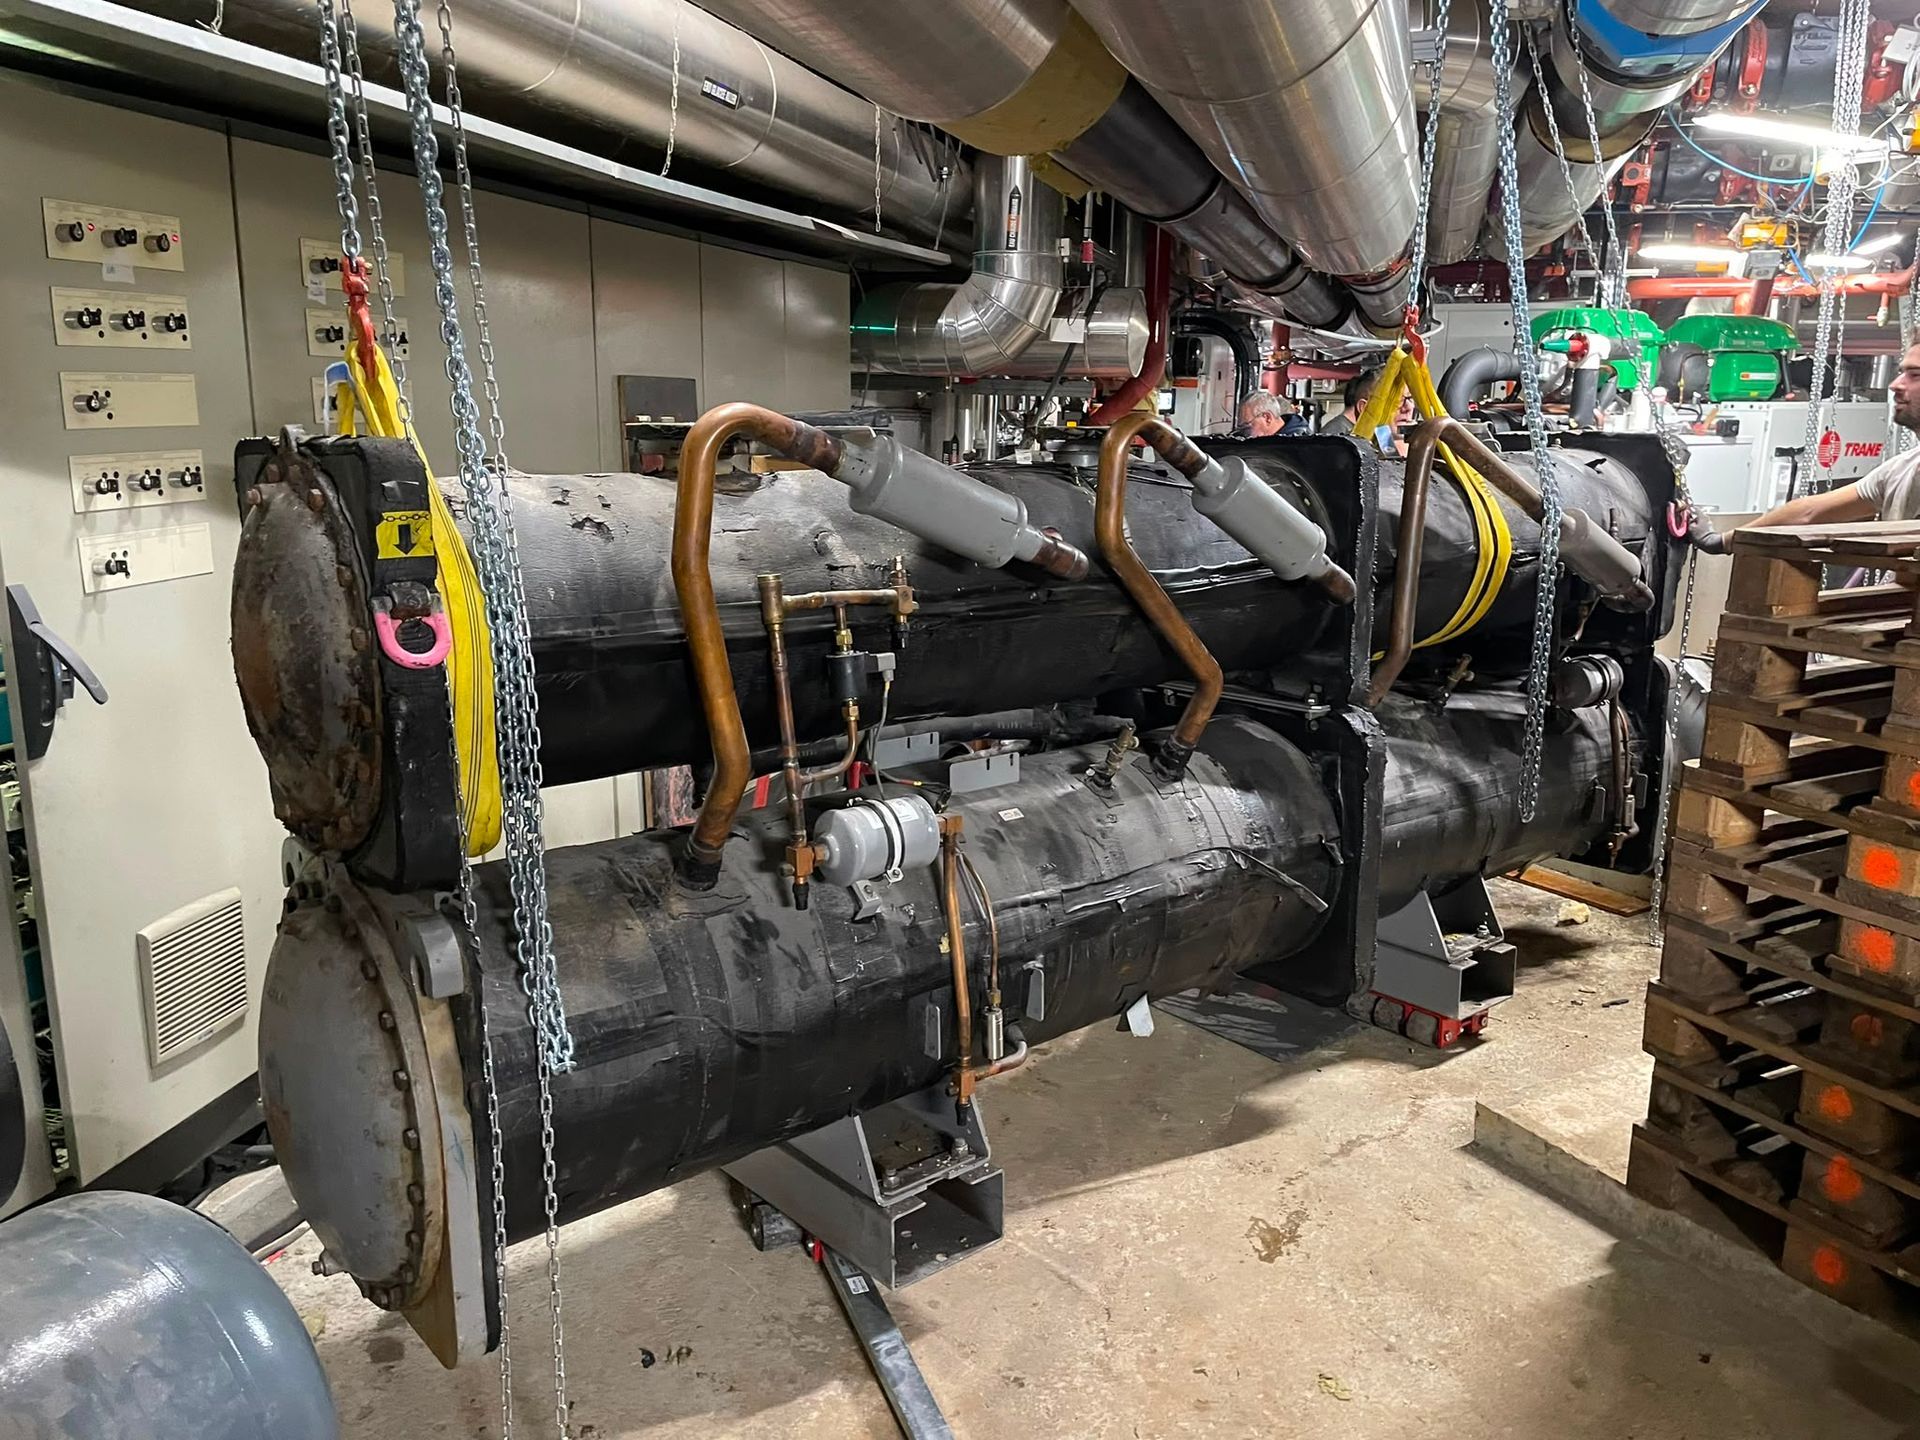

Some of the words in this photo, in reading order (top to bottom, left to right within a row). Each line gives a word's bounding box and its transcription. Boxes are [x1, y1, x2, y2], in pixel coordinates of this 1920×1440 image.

[1009, 220, 1017, 238] CHAUDE
[1008, 238, 1016, 247] EAU
[1845, 442, 1883, 457] TRANE
